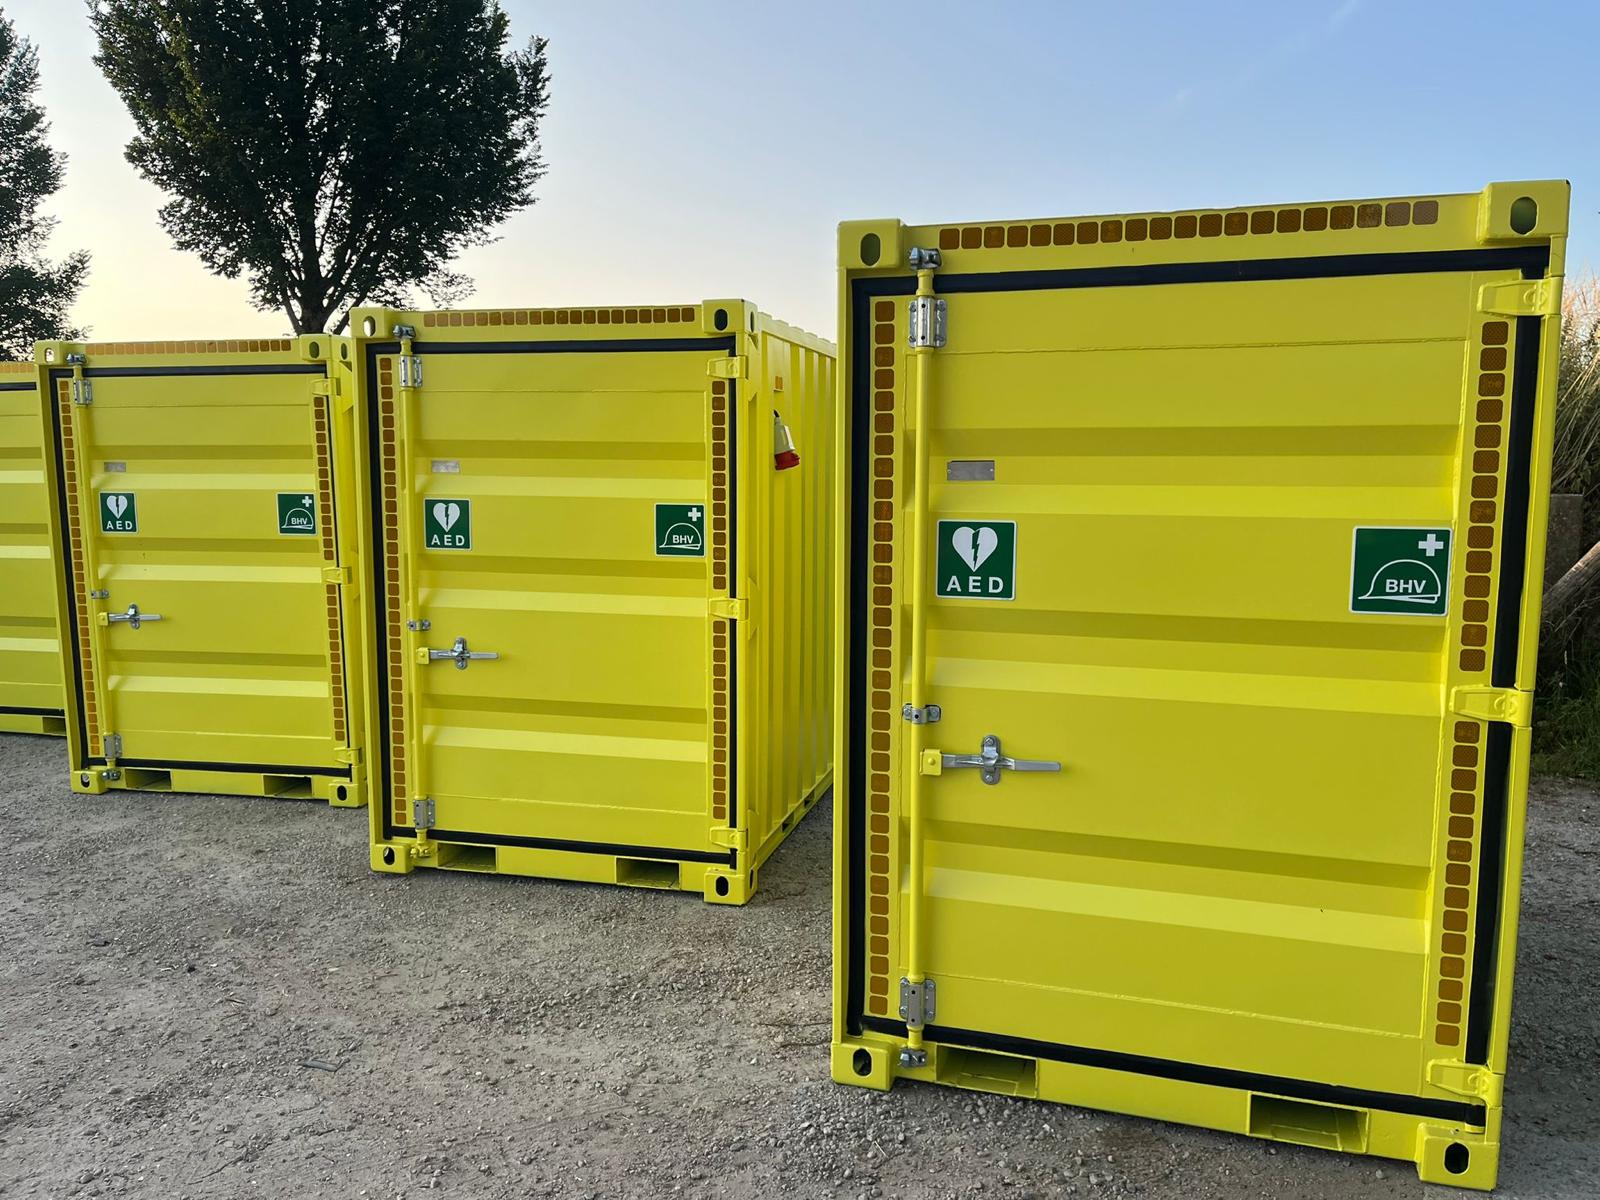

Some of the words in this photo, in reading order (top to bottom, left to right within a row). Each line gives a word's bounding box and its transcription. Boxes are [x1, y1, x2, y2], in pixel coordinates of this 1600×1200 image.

[106, 520, 133, 530] AED
[291, 517, 307, 525] BHV
[431, 534, 465, 546] AED
[672, 534, 694, 544] BHV
[946, 575, 1004, 593] AED
[1385, 579, 1426, 594] BHV
